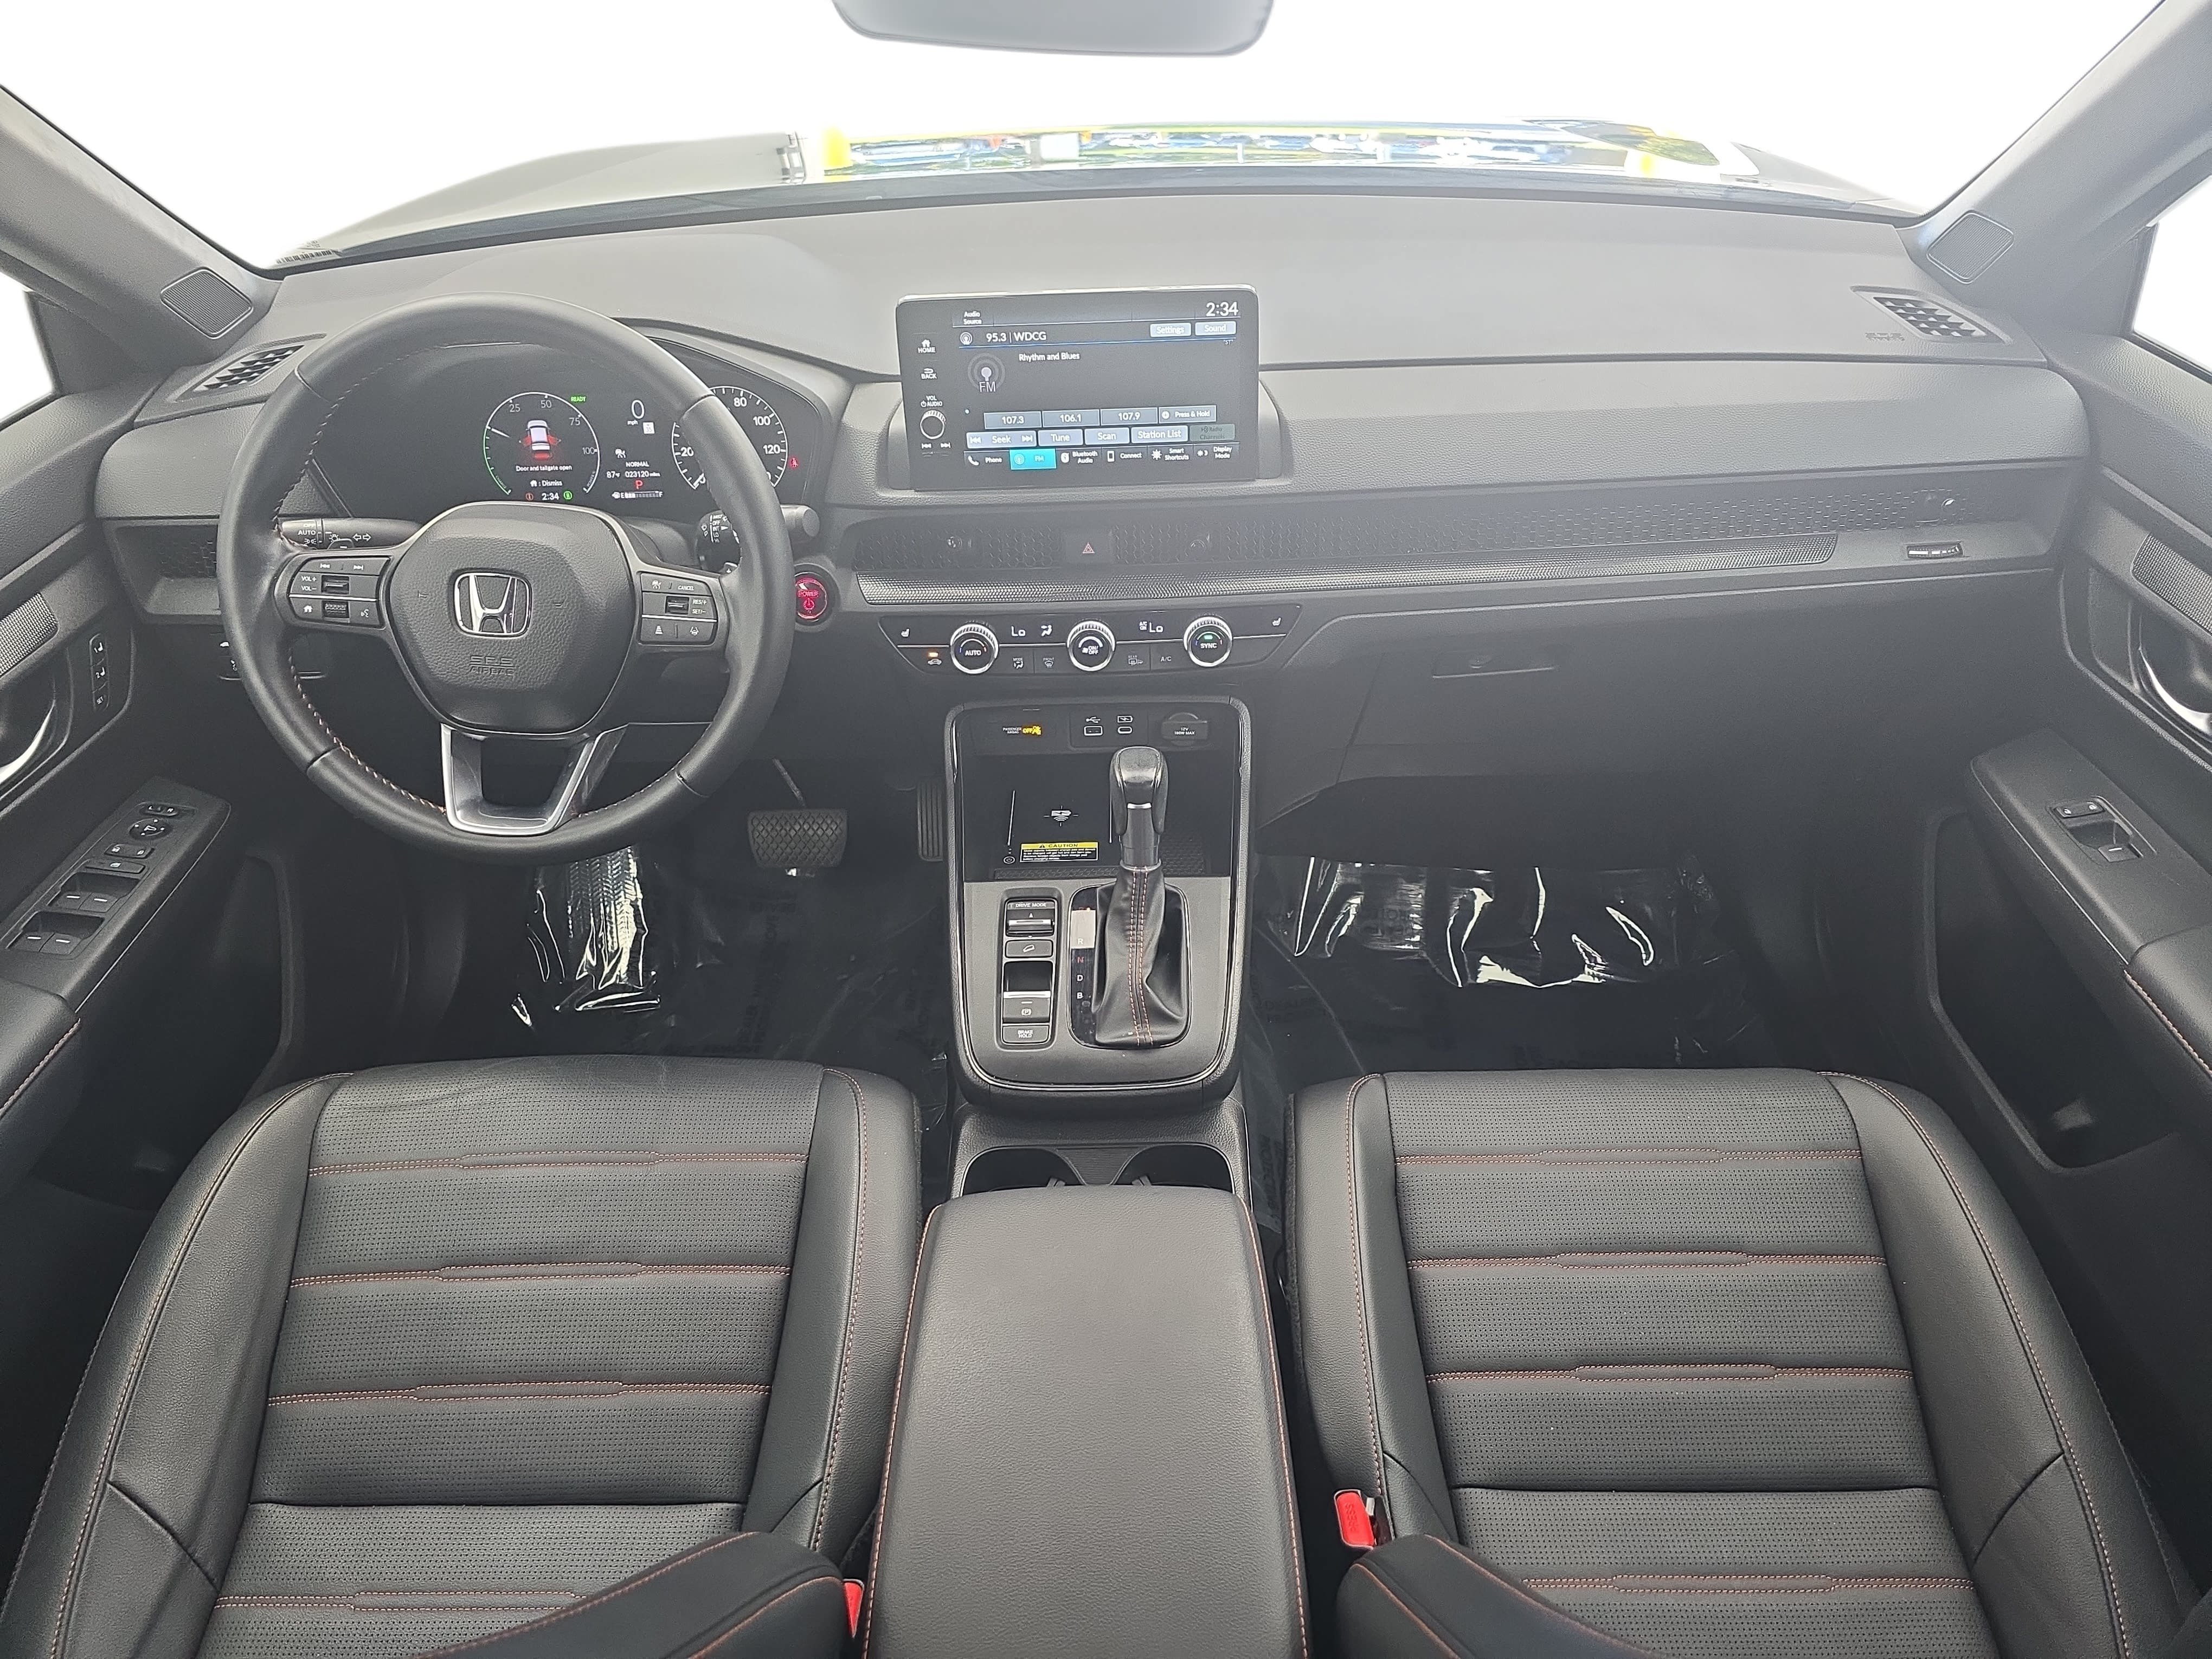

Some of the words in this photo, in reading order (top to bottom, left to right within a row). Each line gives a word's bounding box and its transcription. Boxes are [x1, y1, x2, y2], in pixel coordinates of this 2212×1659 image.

[1206, 301, 1239, 317] 2:34
[1156, 326, 1185, 335] Settings
[1204, 324, 1226, 332] Sound
[986, 332, 1007, 342] 95.3
[1013, 331, 1047, 342] WDCG
[1019, 352, 1046, 362] Rhythm
[1047, 352, 1059, 361] and
[1060, 351, 1080, 360] Blues
[979, 381, 996, 393] FM
[541, 400, 552, 408] 50
[734, 397, 748, 407] 80
[509, 404, 520, 413] 25
[631, 400, 645, 419] 0
[753, 416, 771, 426] 100
[1001, 416, 1024, 425] 107.3
[1060, 414, 1082, 423] 106.1
[1118, 412, 1141, 421] 107.9
[569, 417, 581, 426] 75
[1051, 434, 1070, 442] Tune
[1138, 430, 1166, 439] Station
[1167, 429, 1182, 438] List
[992, 435, 1012, 444] Seek
[680, 447, 694, 457] 20
[763, 445, 781, 454] 120
[1213, 446, 1232, 454] Display
[635, 480, 643, 490] P
[542, 492, 560, 500] 2:34
[1011, 626, 1026, 636] Lo
[1149, 622, 1163, 633] Lo
[1345, 1502, 1358, 1532] PRESS
